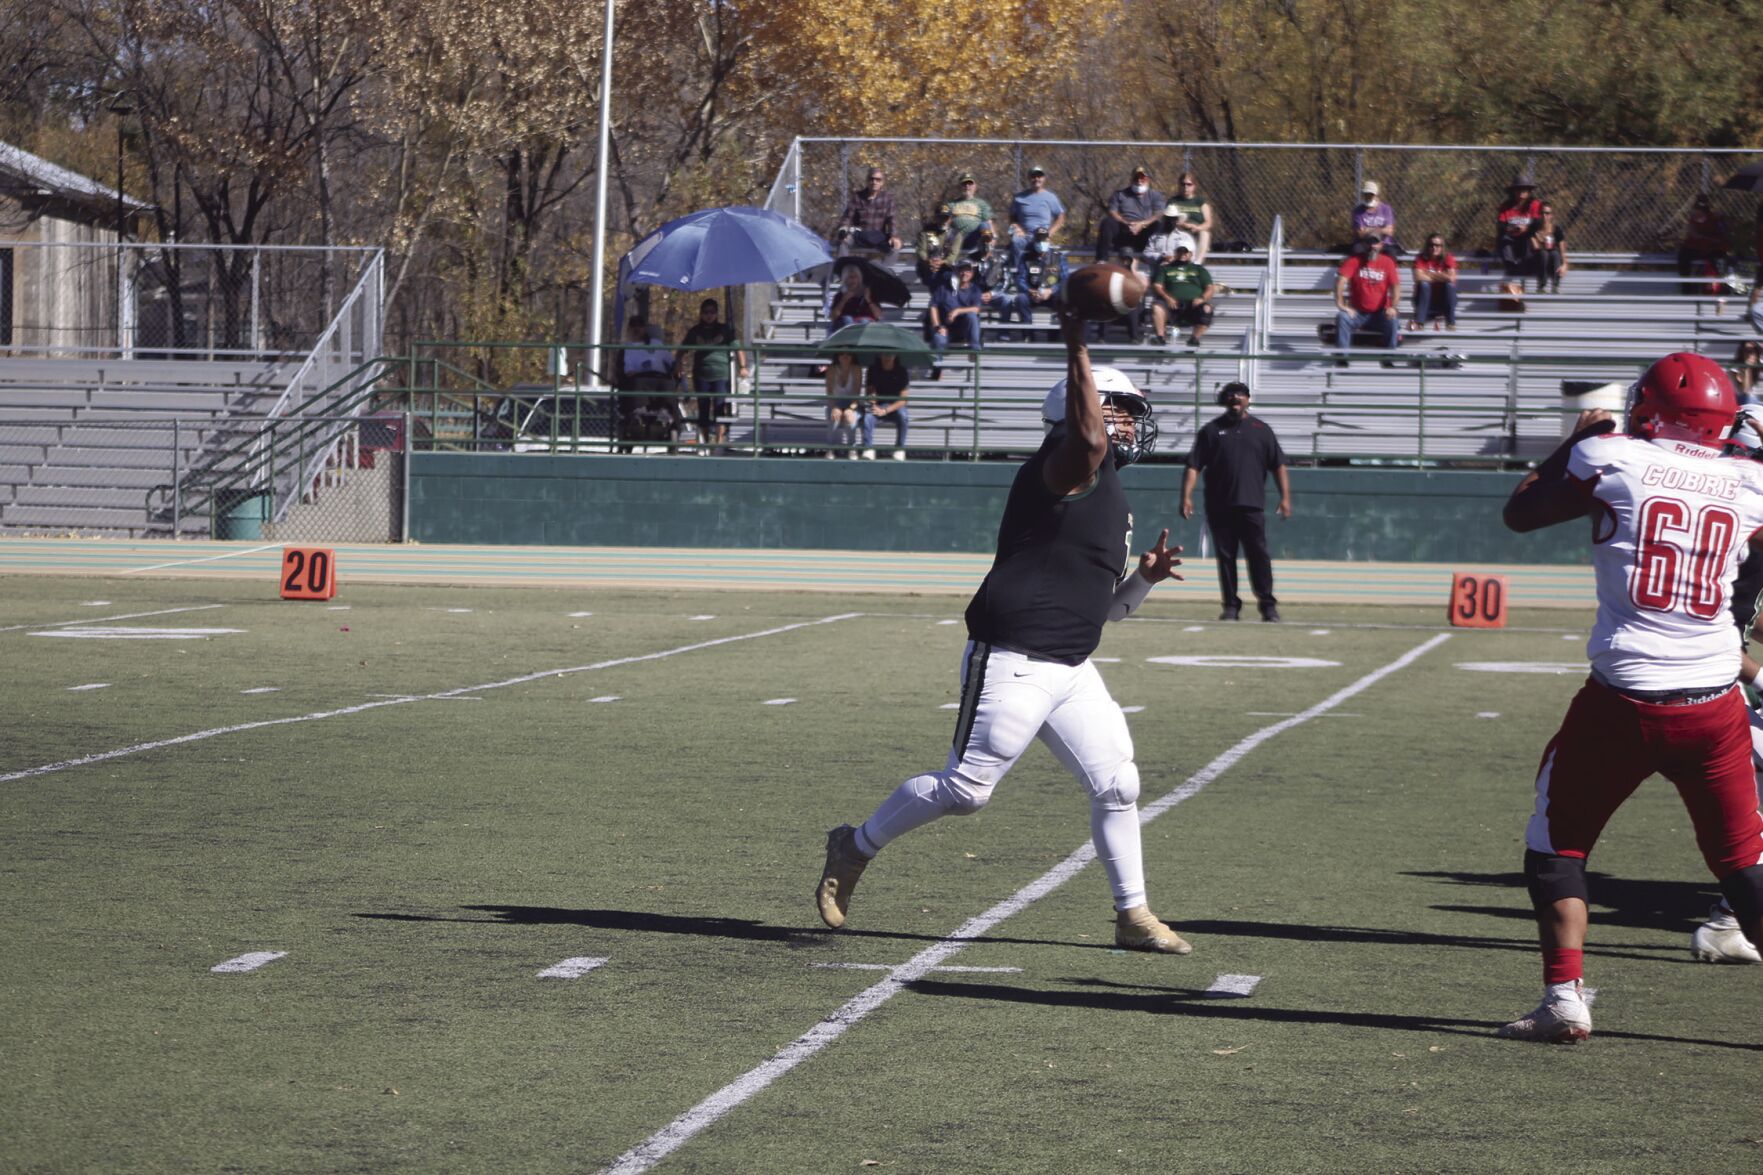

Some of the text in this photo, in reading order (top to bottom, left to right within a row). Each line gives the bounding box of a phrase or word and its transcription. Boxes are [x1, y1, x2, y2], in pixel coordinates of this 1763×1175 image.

[1641, 464, 1741, 500] COBRE
[285, 550, 328, 593] 20
[1630, 496, 1740, 621] 60
[1459, 576, 1502, 622] 30
